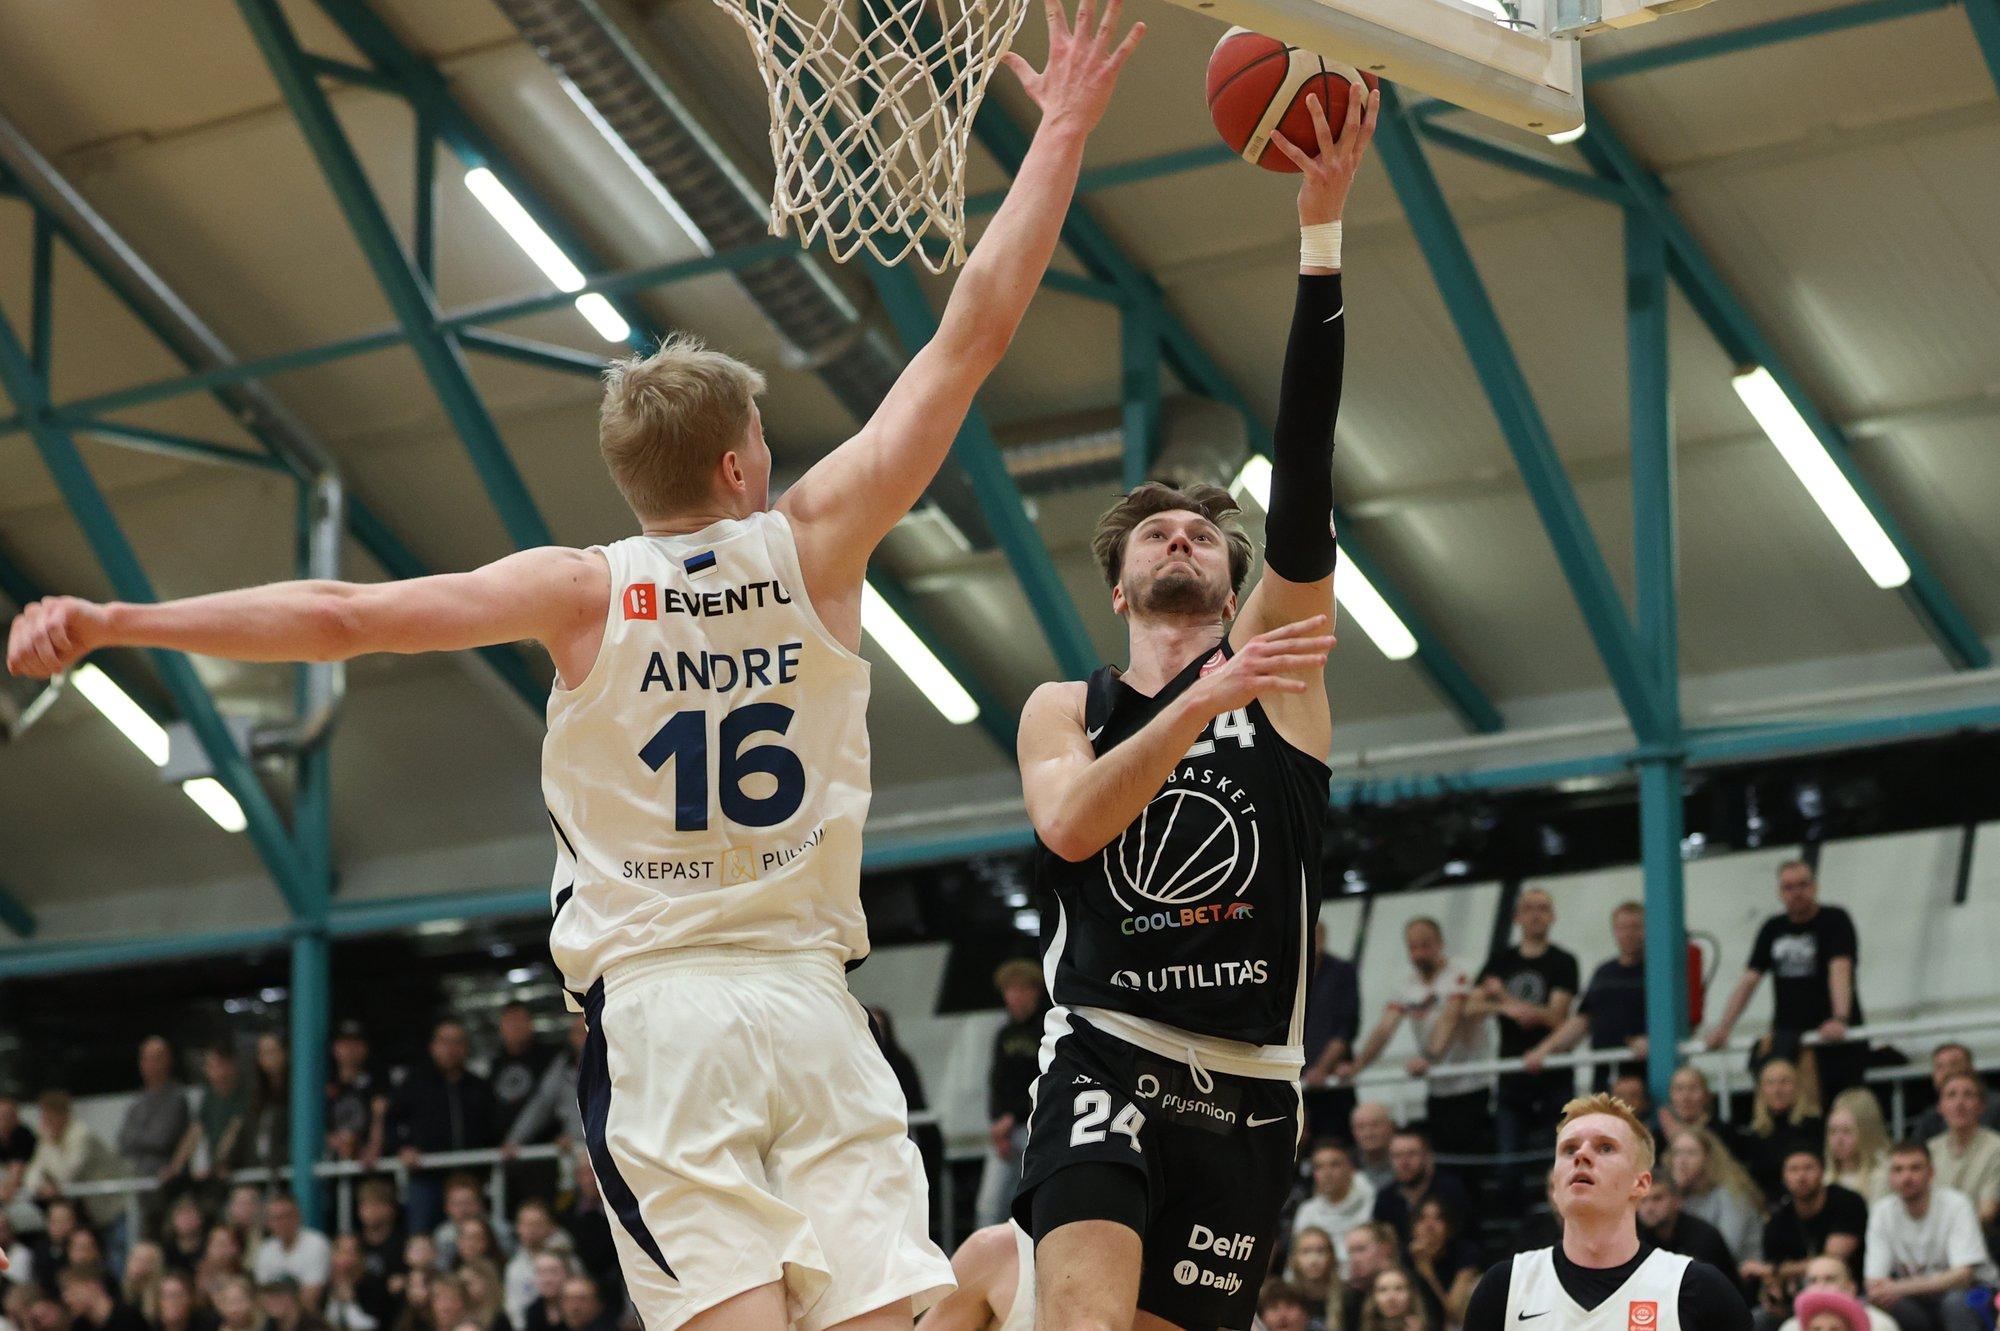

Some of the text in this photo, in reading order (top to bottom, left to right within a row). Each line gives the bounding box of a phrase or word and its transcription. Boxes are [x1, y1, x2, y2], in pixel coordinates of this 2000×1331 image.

[640, 642, 803, 693] ANDRE
[637, 702, 806, 832] 16
[1167, 766, 1257, 816] BASKET
[622, 860, 715, 880] SKEPAST
[1121, 904, 1222, 935] COOLBET
[1147, 959, 1268, 993] UTILITAS
[1069, 1089, 1147, 1154] 24
[1162, 1093, 1236, 1124] prysmian
[1187, 1224, 1256, 1261] Delfi
[1199, 1269, 1243, 1296] Daily
